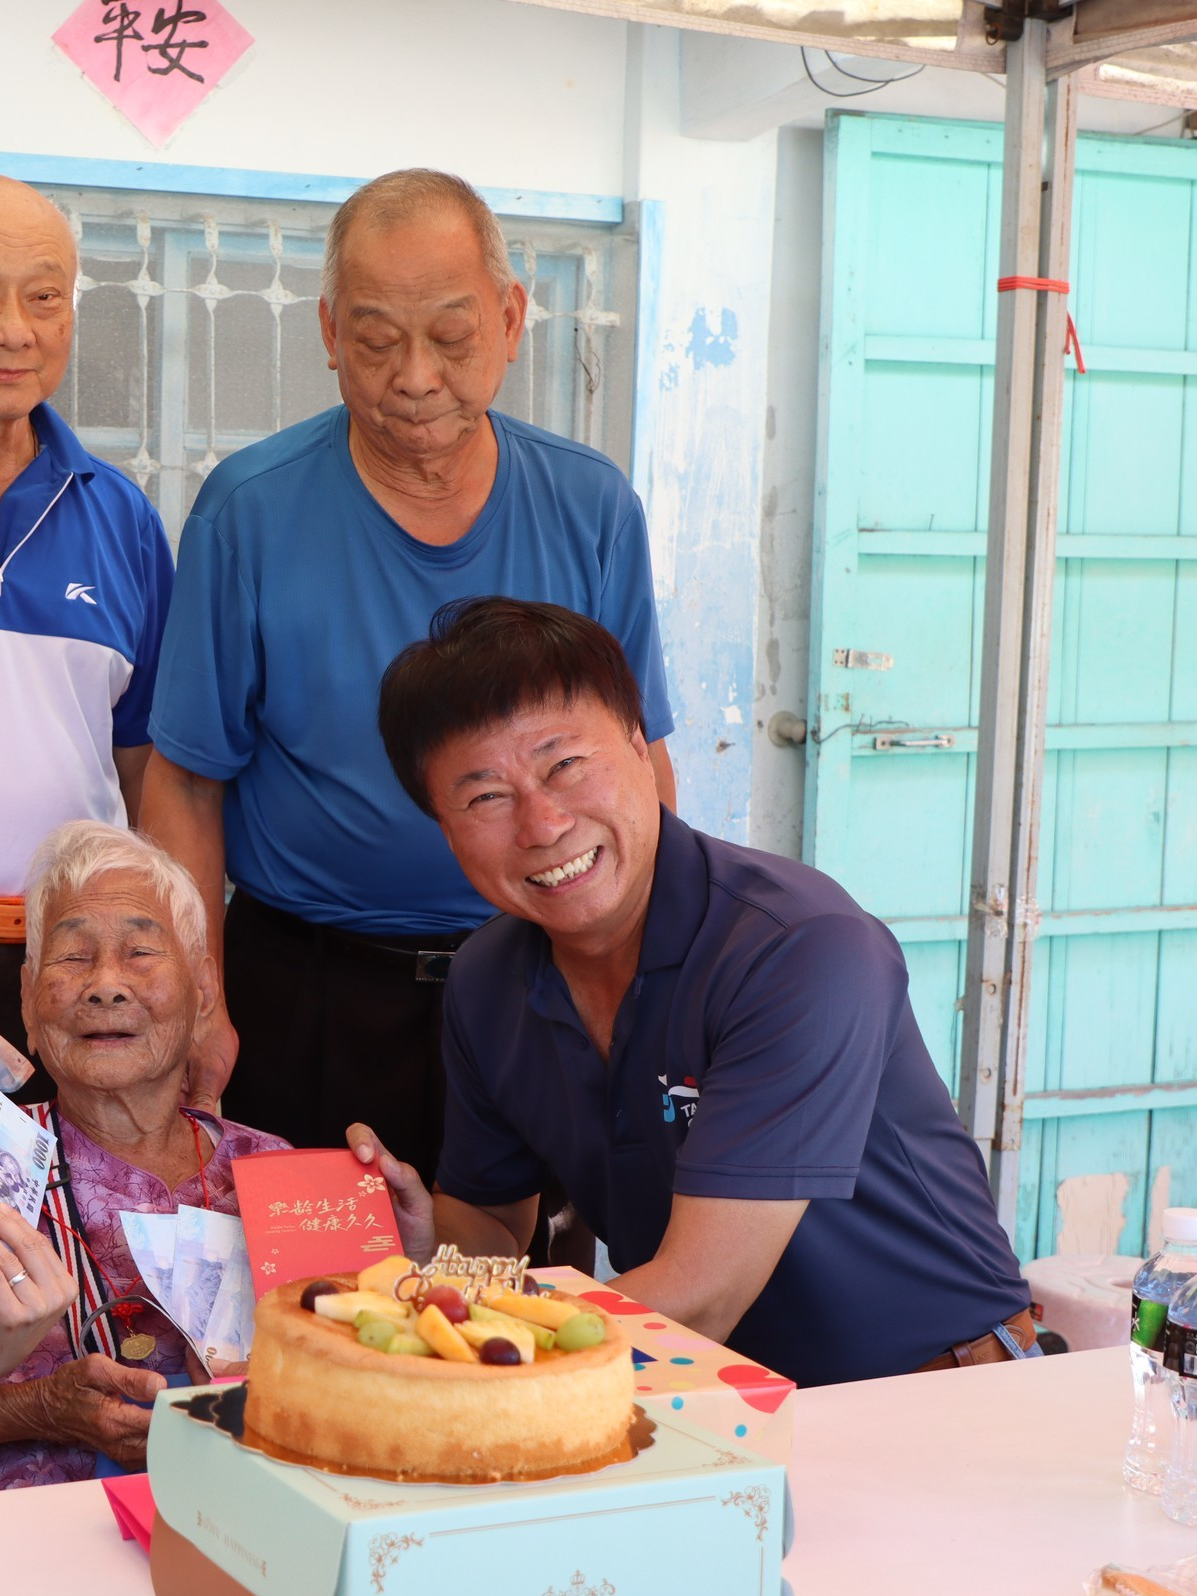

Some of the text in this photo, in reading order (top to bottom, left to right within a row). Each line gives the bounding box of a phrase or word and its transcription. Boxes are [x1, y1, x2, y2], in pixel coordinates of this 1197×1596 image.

[94, 0, 209, 83] 平安
[32, 1131, 50, 1171] 1000
[299, 1213, 384, 1232] 健康久久
[431, 1244, 530, 1299] Happy
